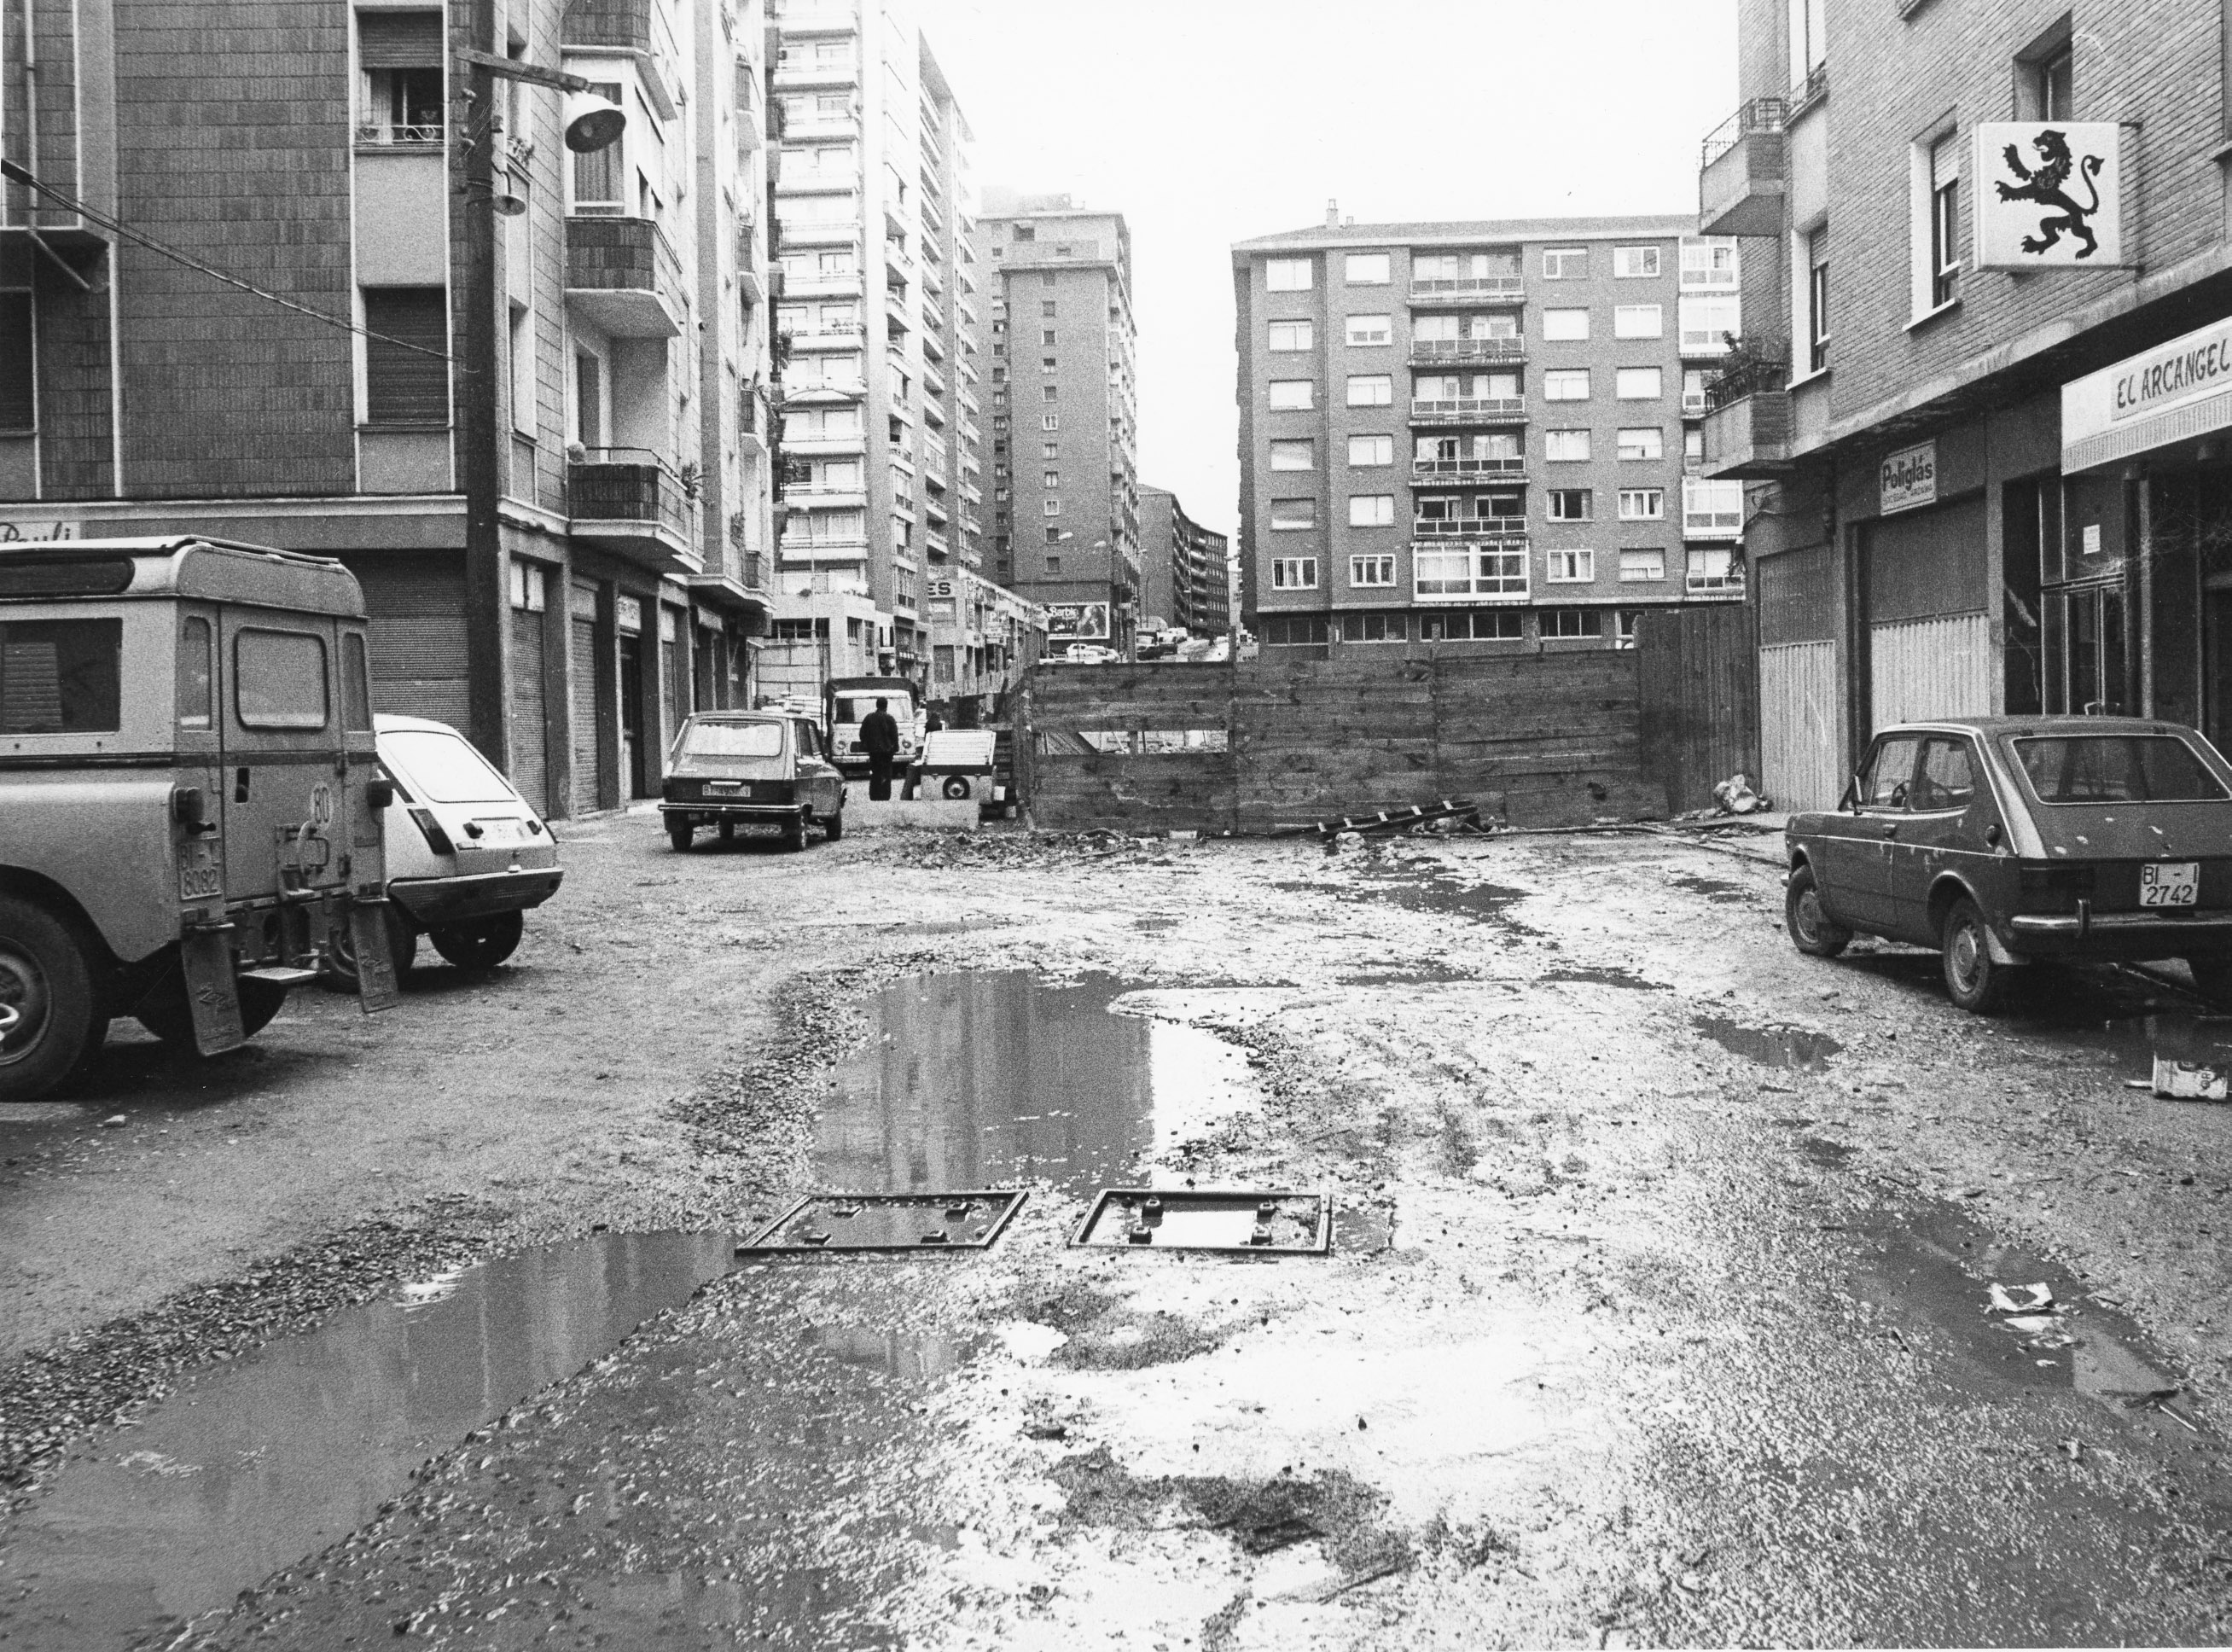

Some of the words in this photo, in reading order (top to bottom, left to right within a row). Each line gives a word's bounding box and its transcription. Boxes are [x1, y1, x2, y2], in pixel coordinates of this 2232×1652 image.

[2117, 374, 2136, 409] EL
[2141, 338, 2230, 401] ARCANGEL
[1882, 455, 1933, 492] Poliglás
[313, 786, 329, 825] 80
[2146, 884, 2193, 905] 2742
